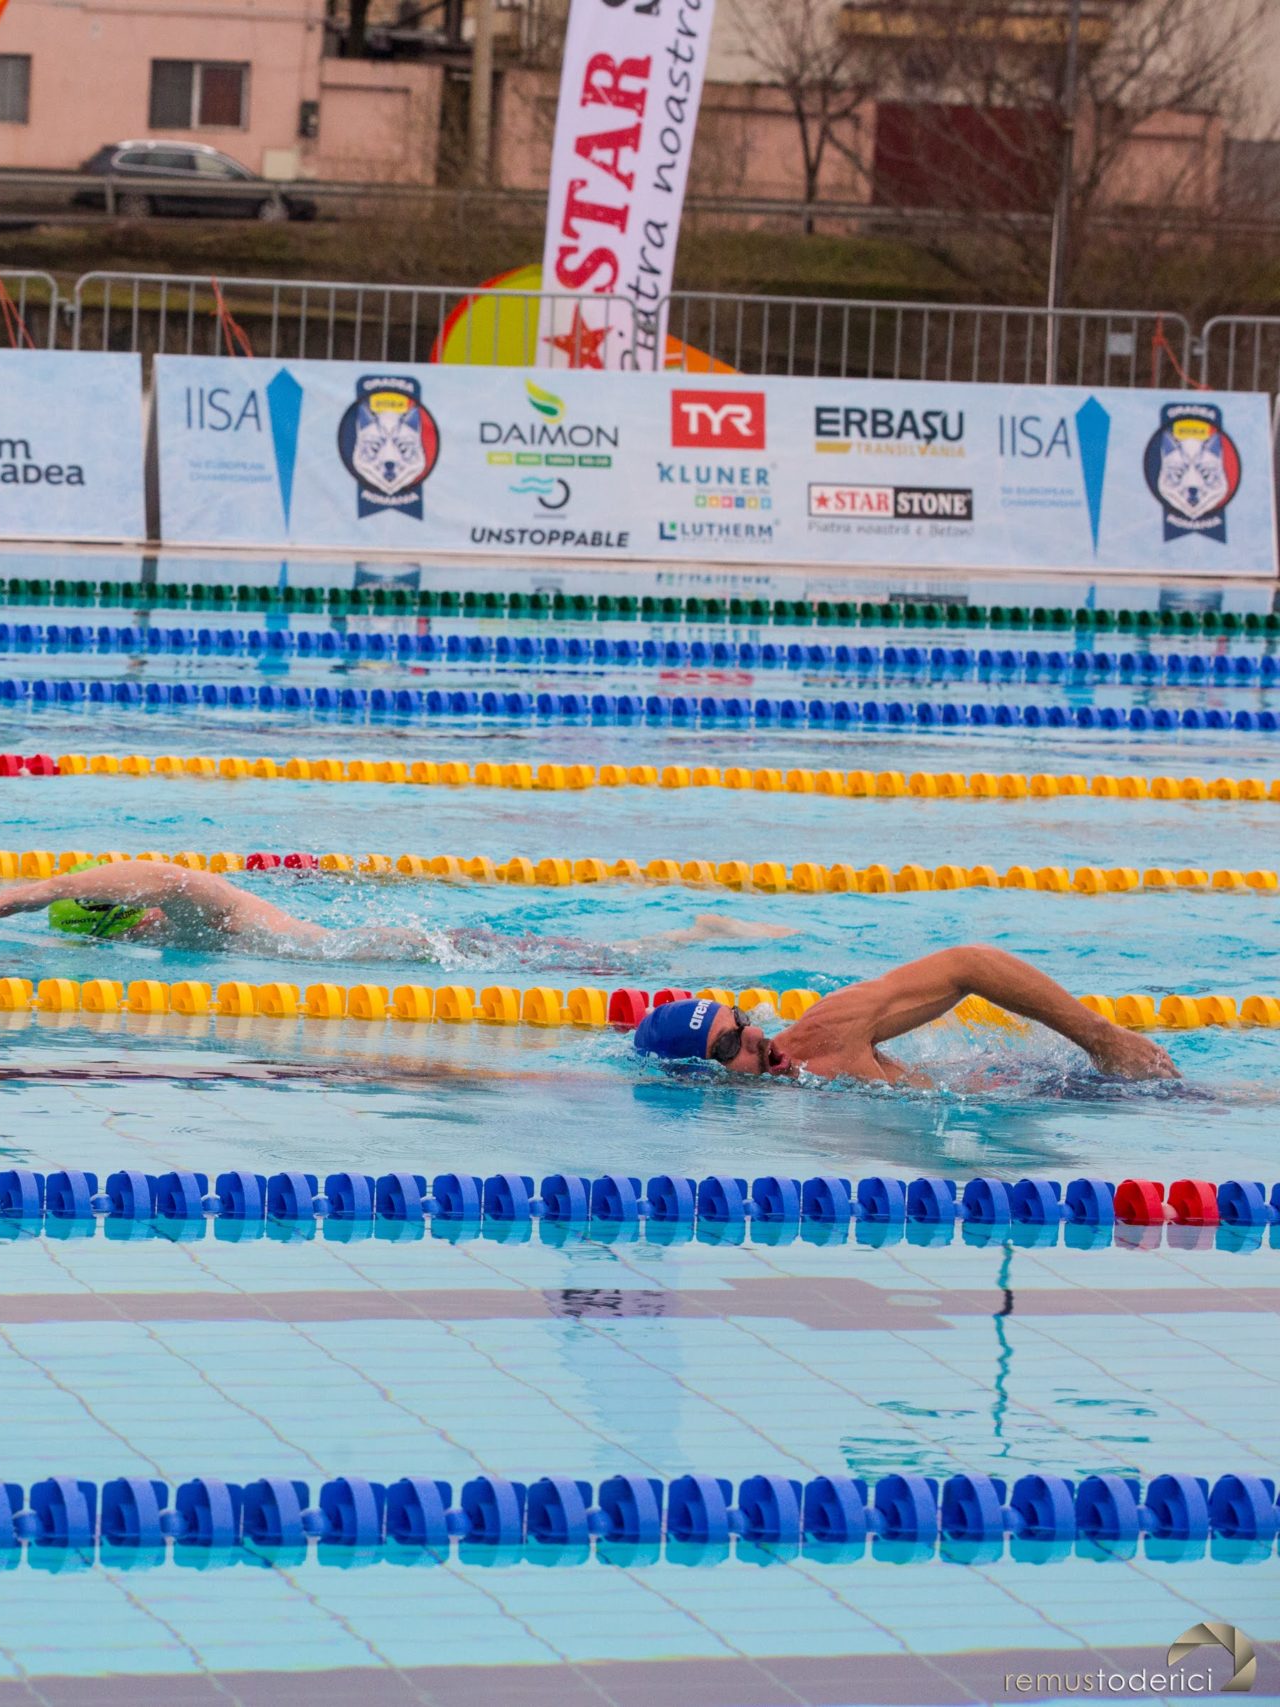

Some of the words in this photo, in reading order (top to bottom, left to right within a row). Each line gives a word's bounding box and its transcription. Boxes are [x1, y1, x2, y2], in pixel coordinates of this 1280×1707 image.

[555, 53, 652, 294] STAR
[186, 387, 262, 432] IISA
[680, 402, 755, 436] TYR
[480, 422, 618, 447] DAIMON
[998, 415, 1071, 459] IISA
[856, 442, 966, 458] TRANSILVANIA
[658, 463, 769, 486] KLUNER
[833, 490, 890, 512] STAR
[896, 492, 968, 516] STONE
[471, 528, 629, 547] UNSTOPPABLE
[681, 522, 773, 538] LUTHERM
